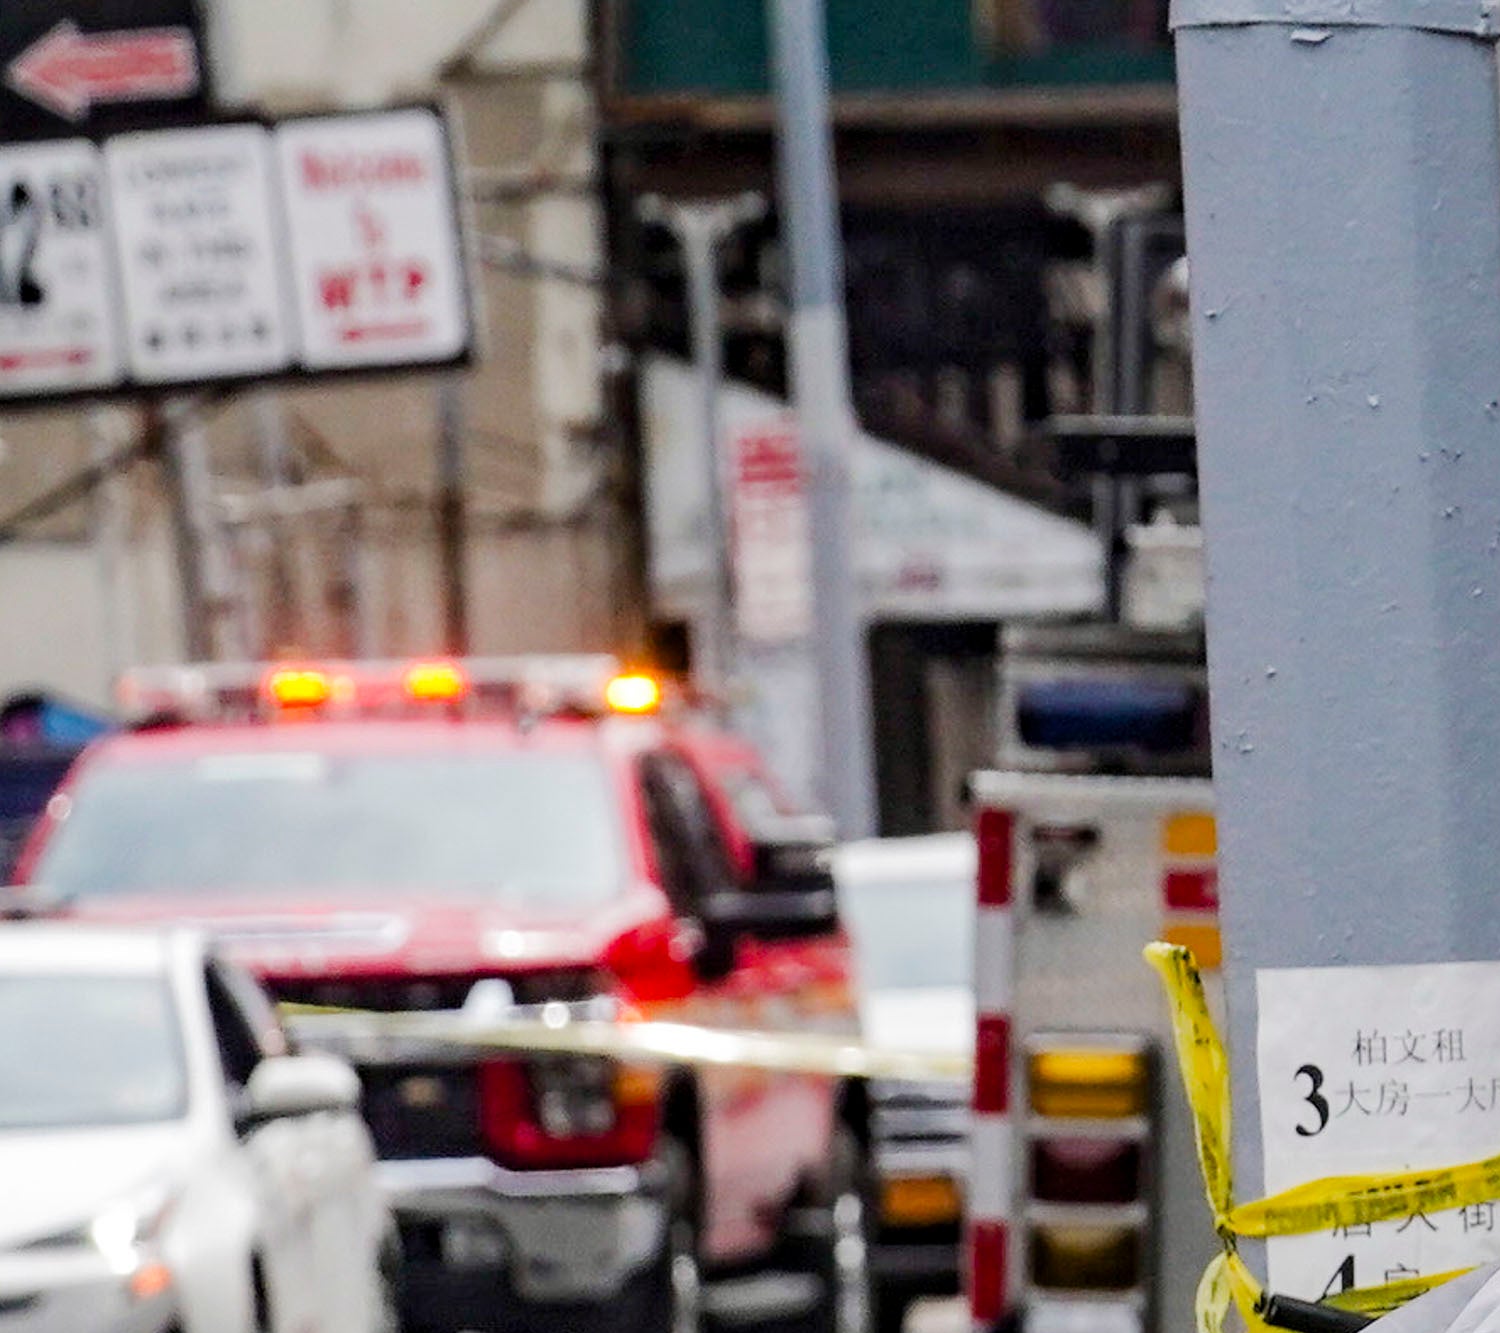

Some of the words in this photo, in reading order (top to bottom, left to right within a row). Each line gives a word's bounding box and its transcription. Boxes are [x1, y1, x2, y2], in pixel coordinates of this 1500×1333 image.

[1351, 1029, 1466, 1067] 柏文租
[1294, 1064, 1330, 1137] 3
